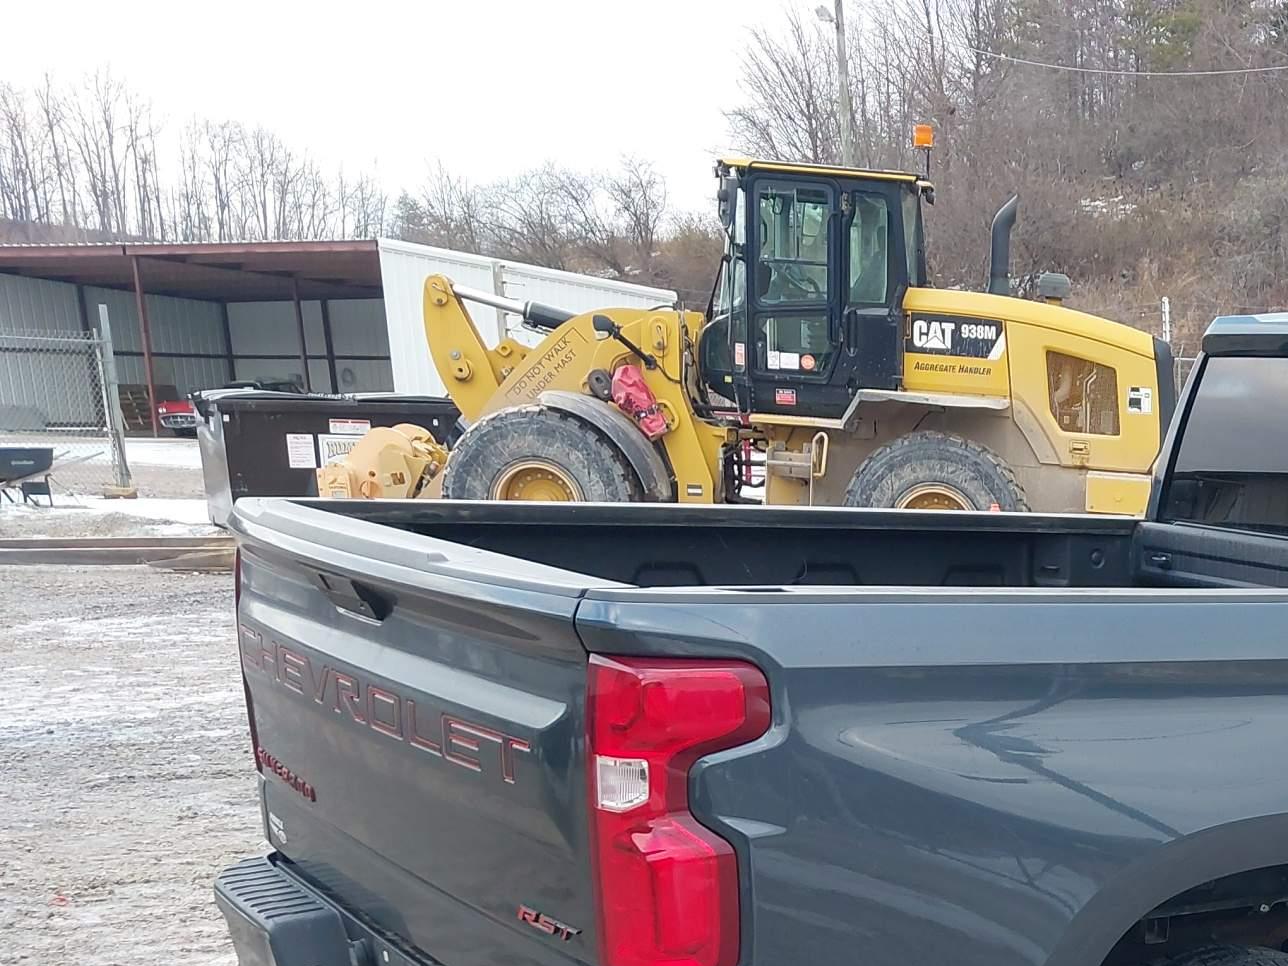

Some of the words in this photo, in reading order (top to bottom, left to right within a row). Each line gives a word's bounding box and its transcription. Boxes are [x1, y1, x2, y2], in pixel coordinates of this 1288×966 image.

[912, 320, 955, 350] CAT
[961, 324, 997, 340] 938M
[513, 379, 528, 395] DO
[526, 361, 546, 382] NOT
[544, 335, 571, 361] WALK
[527, 371, 556, 399] UNDER
[553, 348, 577, 373] MAST
[240, 623, 531, 785] CHEVROLET
[517, 903, 583, 941] RST
